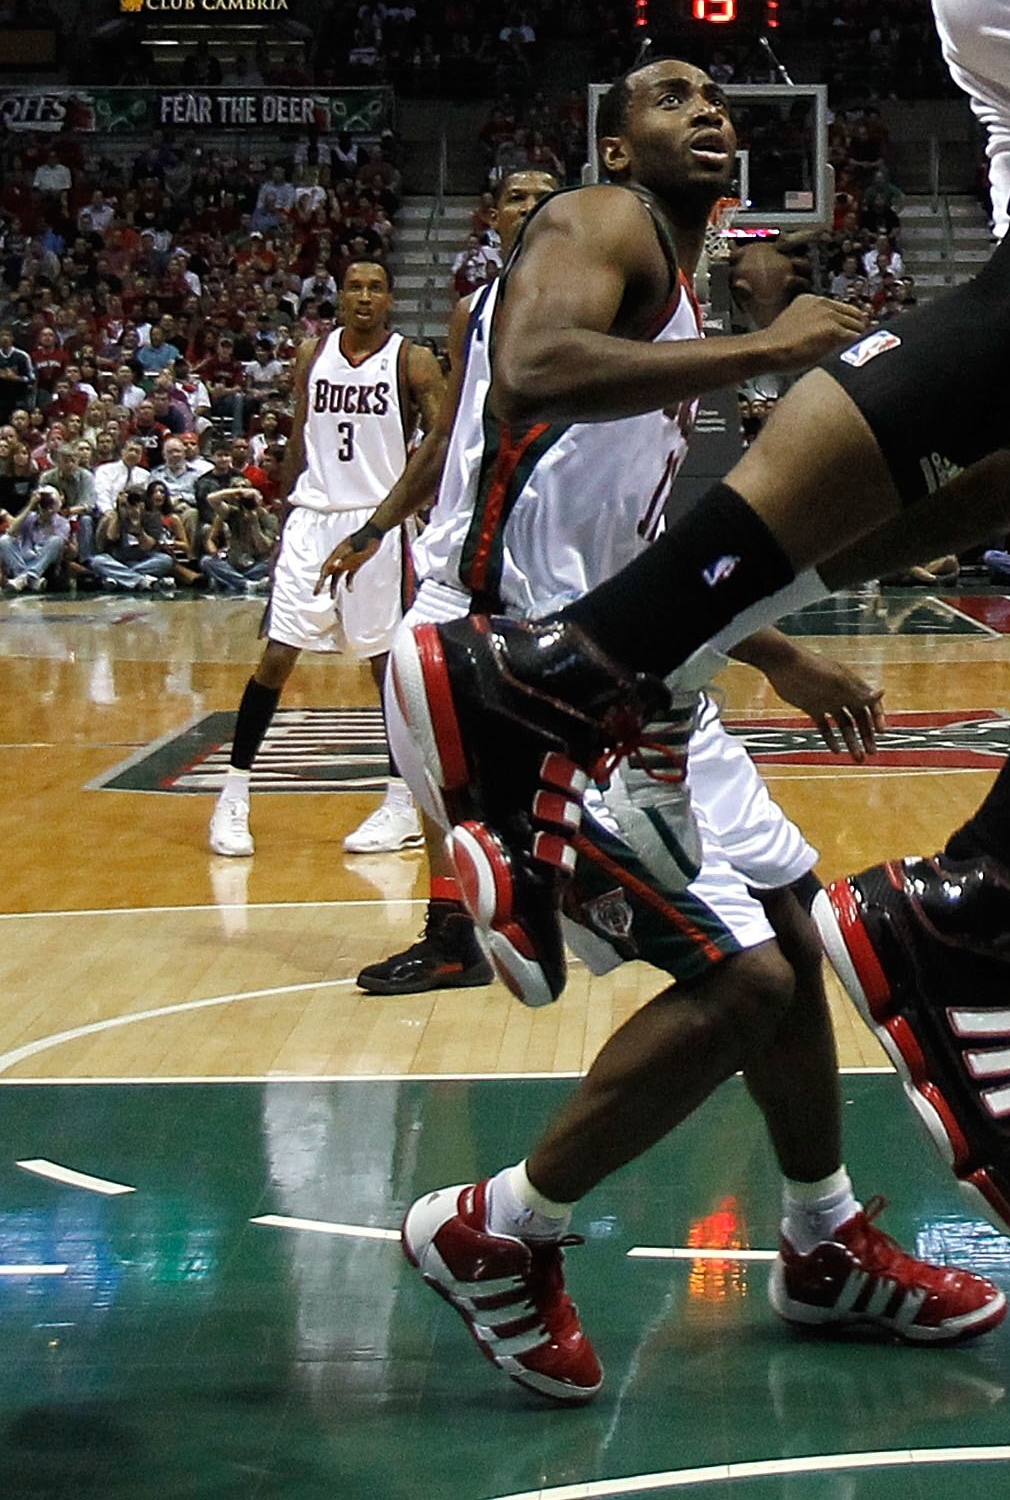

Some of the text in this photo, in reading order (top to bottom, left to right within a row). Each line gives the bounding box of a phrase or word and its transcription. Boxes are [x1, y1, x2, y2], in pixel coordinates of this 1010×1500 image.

[160, 95, 315, 125] FEAR THE DEER
[314, 378, 391, 416] BUCKS
[337, 421, 355, 462] 3
